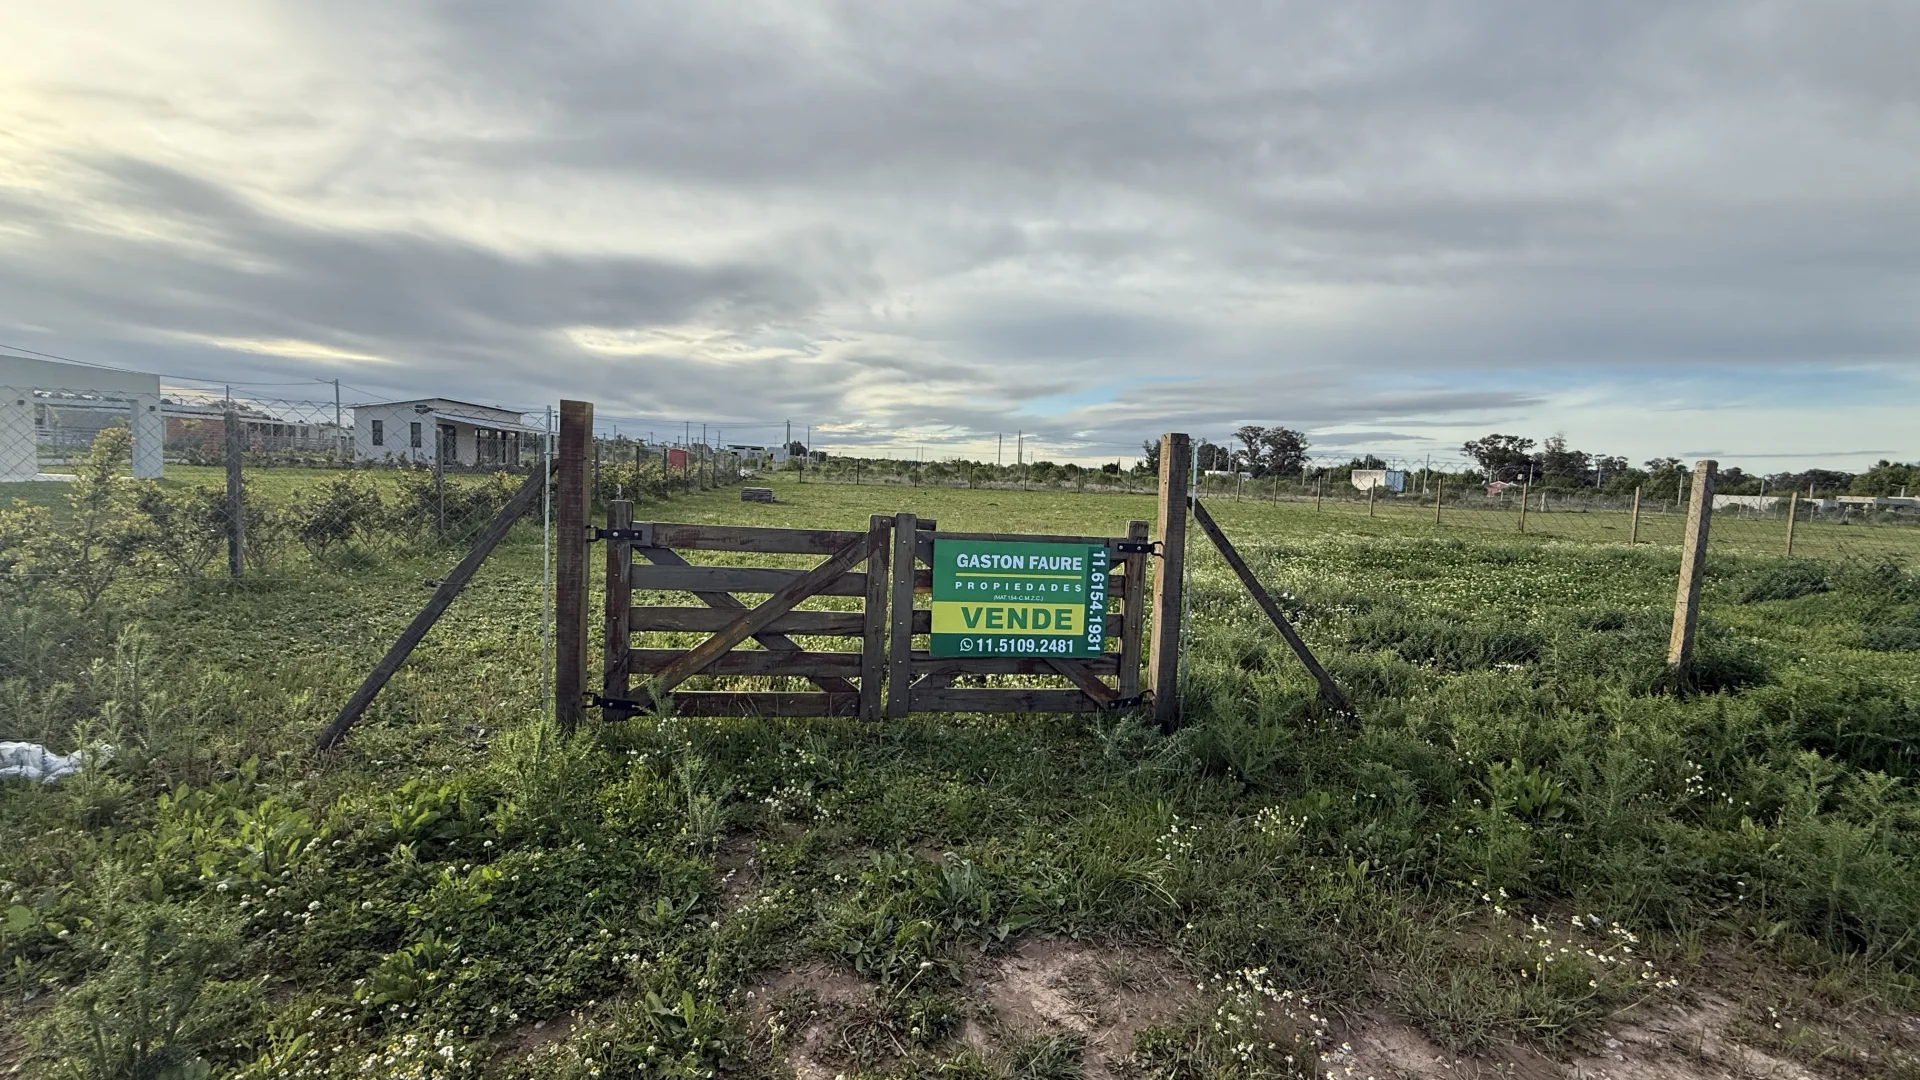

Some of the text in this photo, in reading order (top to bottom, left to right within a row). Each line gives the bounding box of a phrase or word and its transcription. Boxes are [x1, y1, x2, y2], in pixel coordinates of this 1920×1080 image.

[956, 553, 1082, 570] GASTON FAURE
[955, 581, 1082, 592] PROPIEDADES
[1087, 550, 1106, 651] 11.6154.1931
[961, 606, 1073, 630] VENDE
[976, 638, 1073, 653] 11.5109.2481
